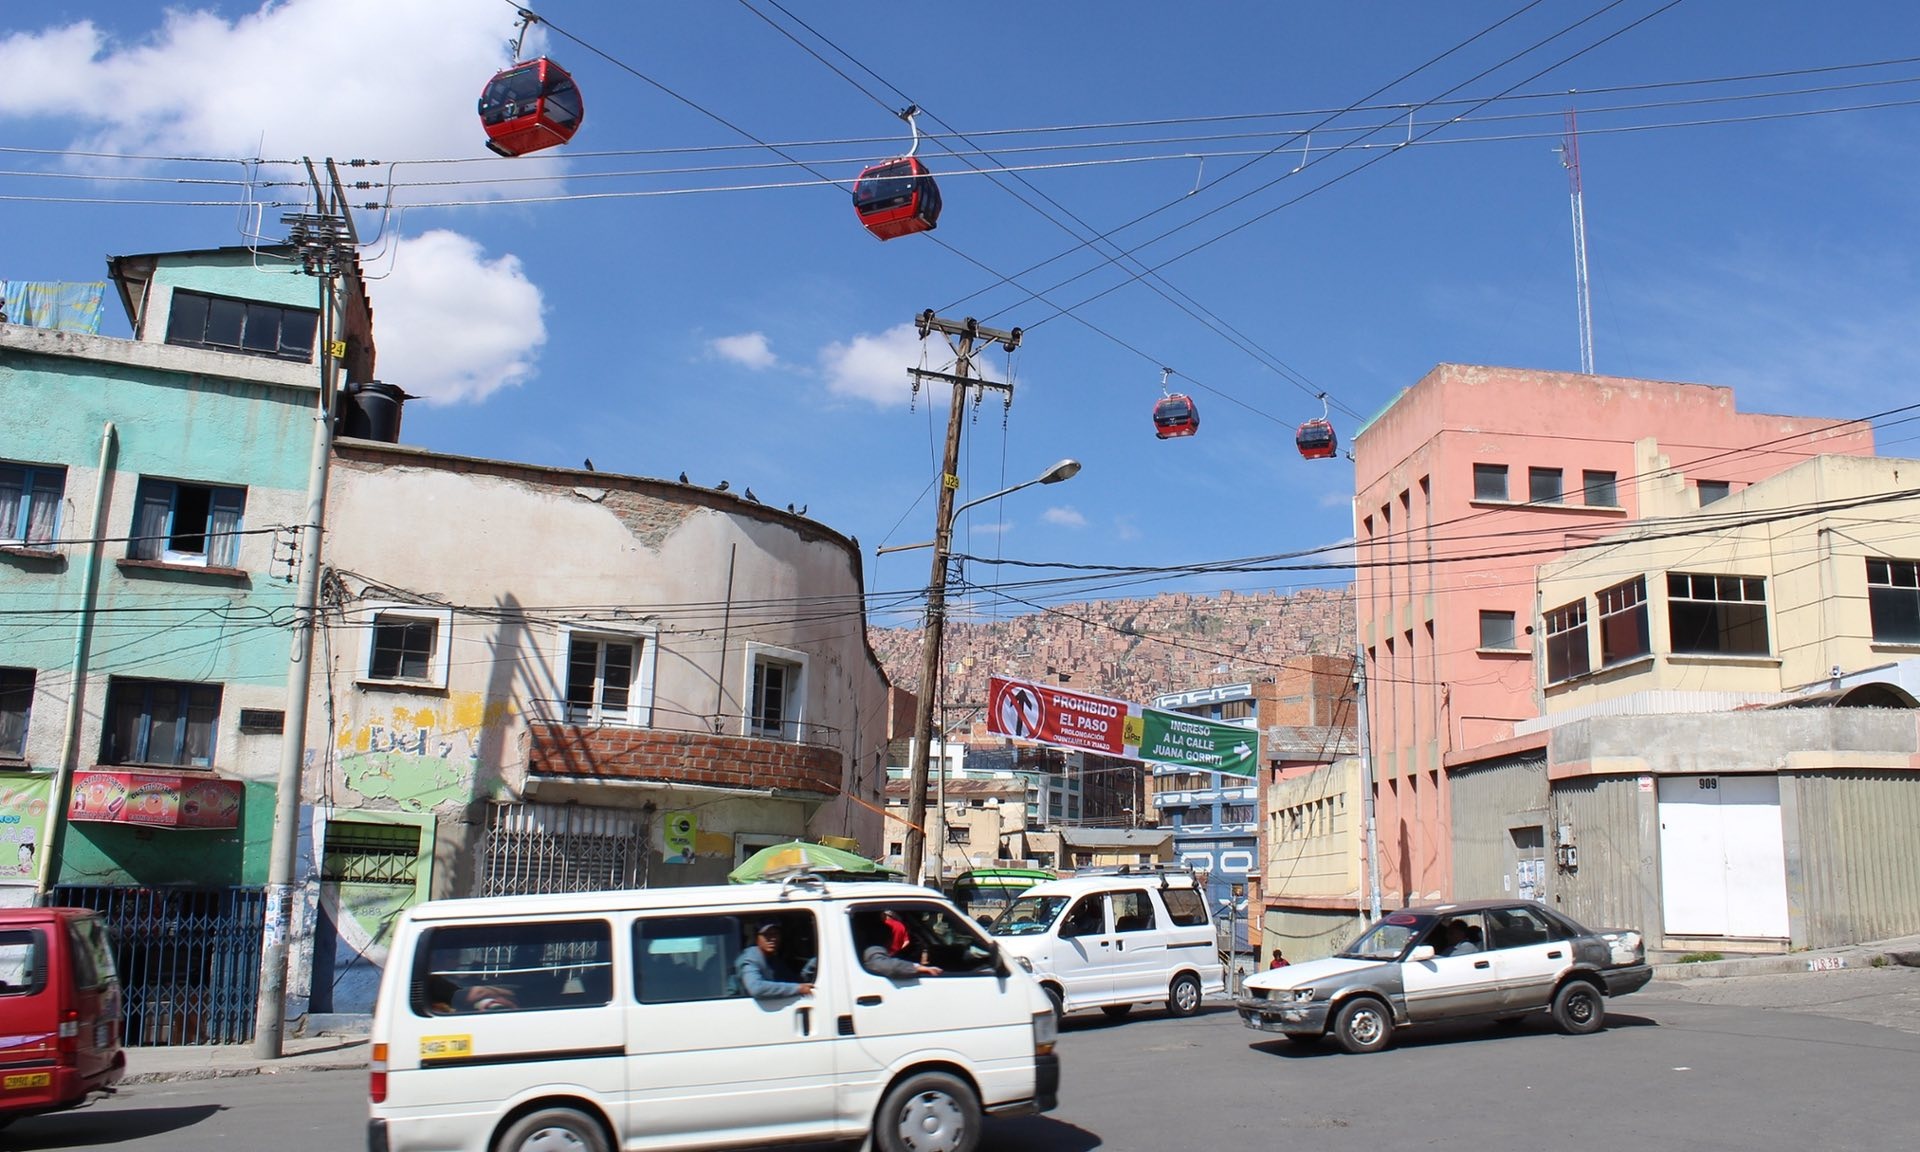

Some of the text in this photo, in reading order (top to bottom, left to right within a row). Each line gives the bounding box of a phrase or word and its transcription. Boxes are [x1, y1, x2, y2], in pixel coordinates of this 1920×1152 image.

[1053, 695, 1118, 718] PROHIBIDO
[1060, 713, 1108, 732] EL PASO
[1170, 720, 1211, 736] INGRESO
[1053, 735, 1090, 746] QUINTANILLA
[1163, 733, 1214, 751] A LA CALLE
[1152, 744, 1222, 766] JUANA GORRITI
[1699, 778, 1717, 790] 909
